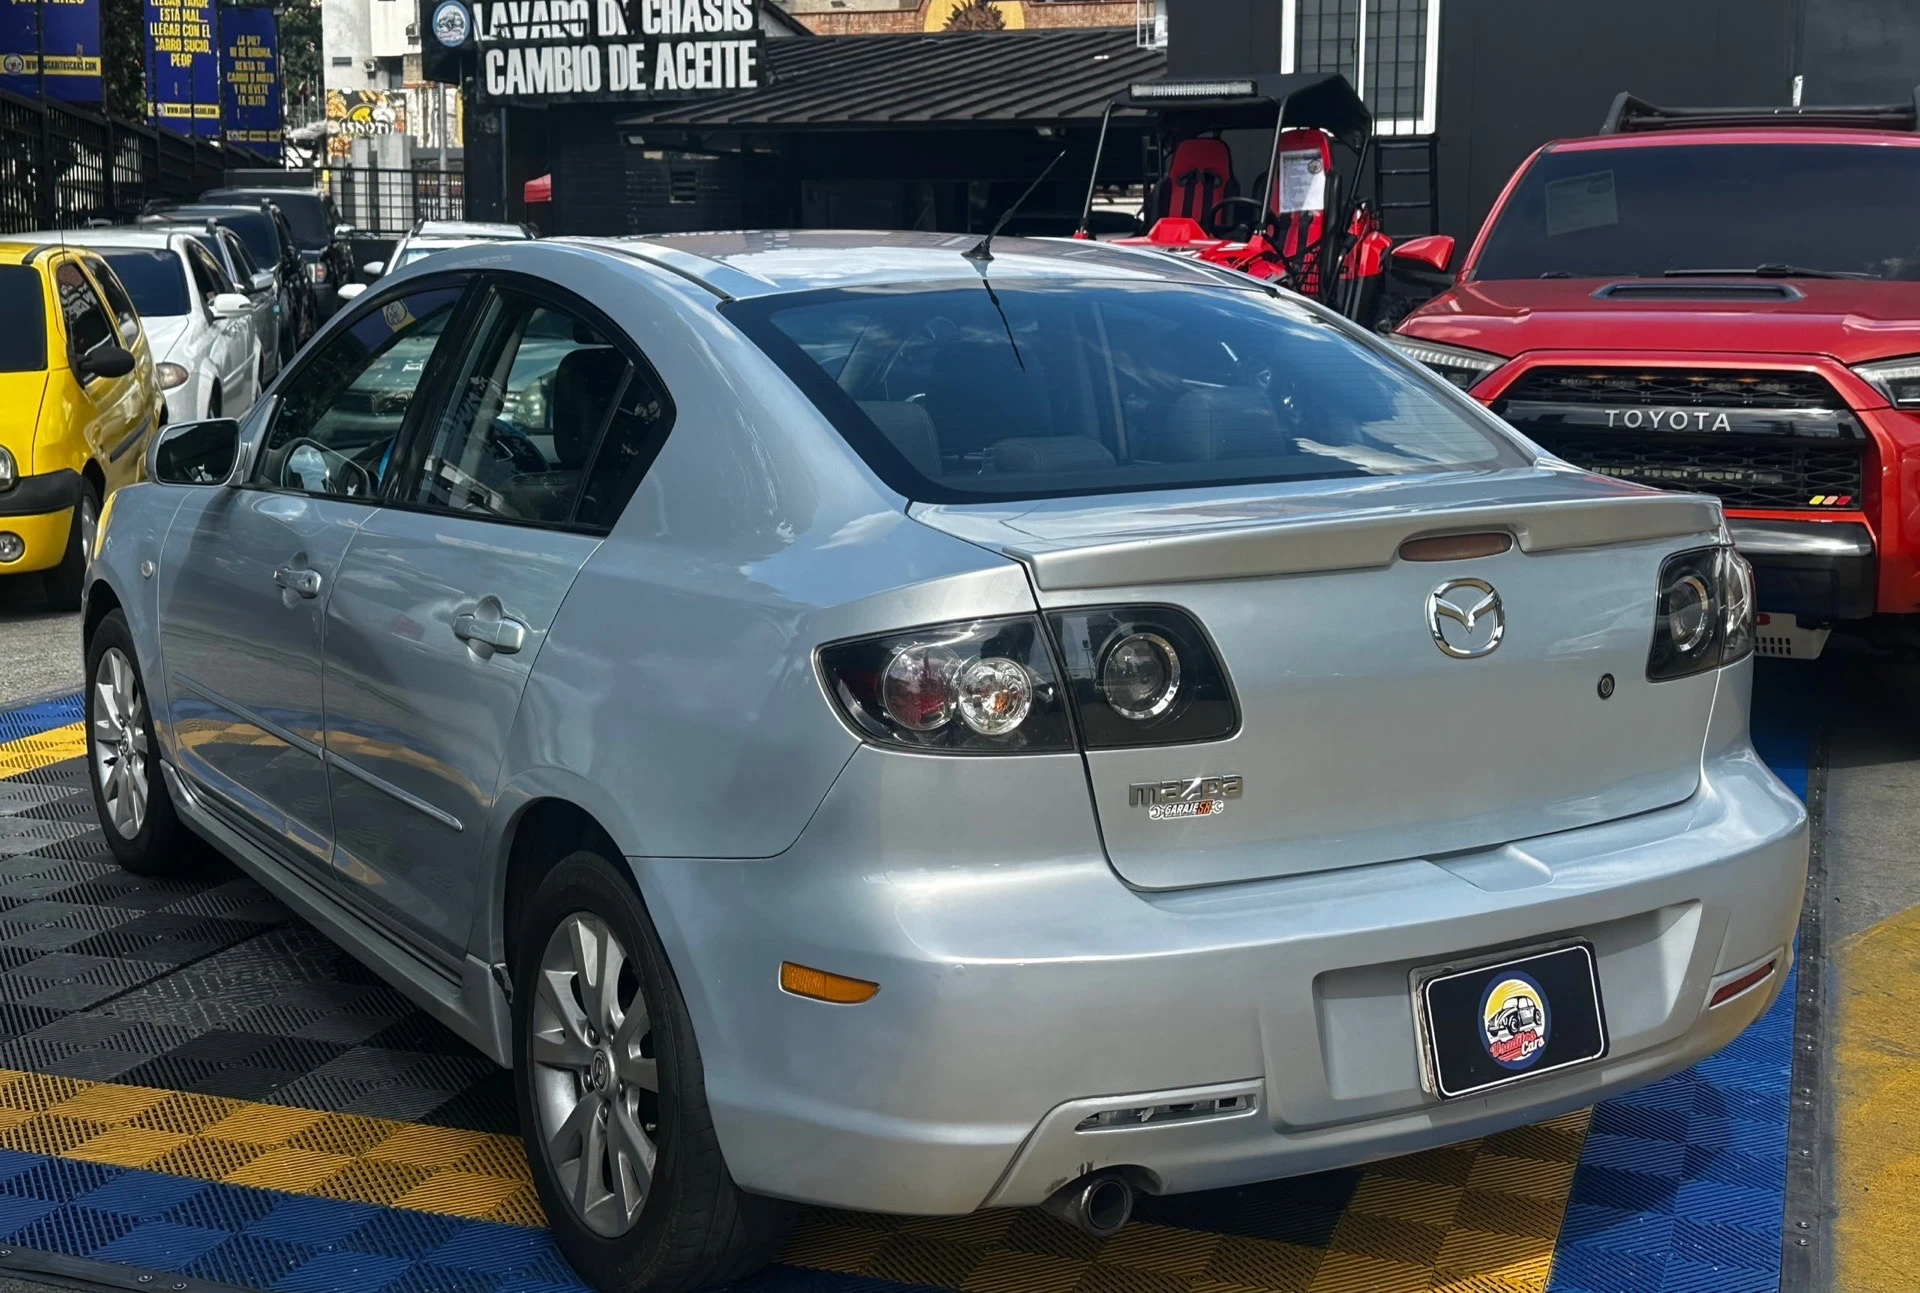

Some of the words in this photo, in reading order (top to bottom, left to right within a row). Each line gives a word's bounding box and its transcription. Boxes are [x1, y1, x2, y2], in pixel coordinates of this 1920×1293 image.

[150, 22, 181, 36] LLEGAR
[182, 23, 200, 37] CON
[202, 24, 211, 38] EL
[472, 0, 589, 41] LAVADO
[642, 0, 753, 35] CHASIS
[485, 44, 601, 96] CAMBIO
[608, 43, 646, 91] DE
[654, 40, 758, 90] ACEITE
[1604, 409, 1731, 431] TOYOTA
[1521, 1036, 1545, 1056] Cars
